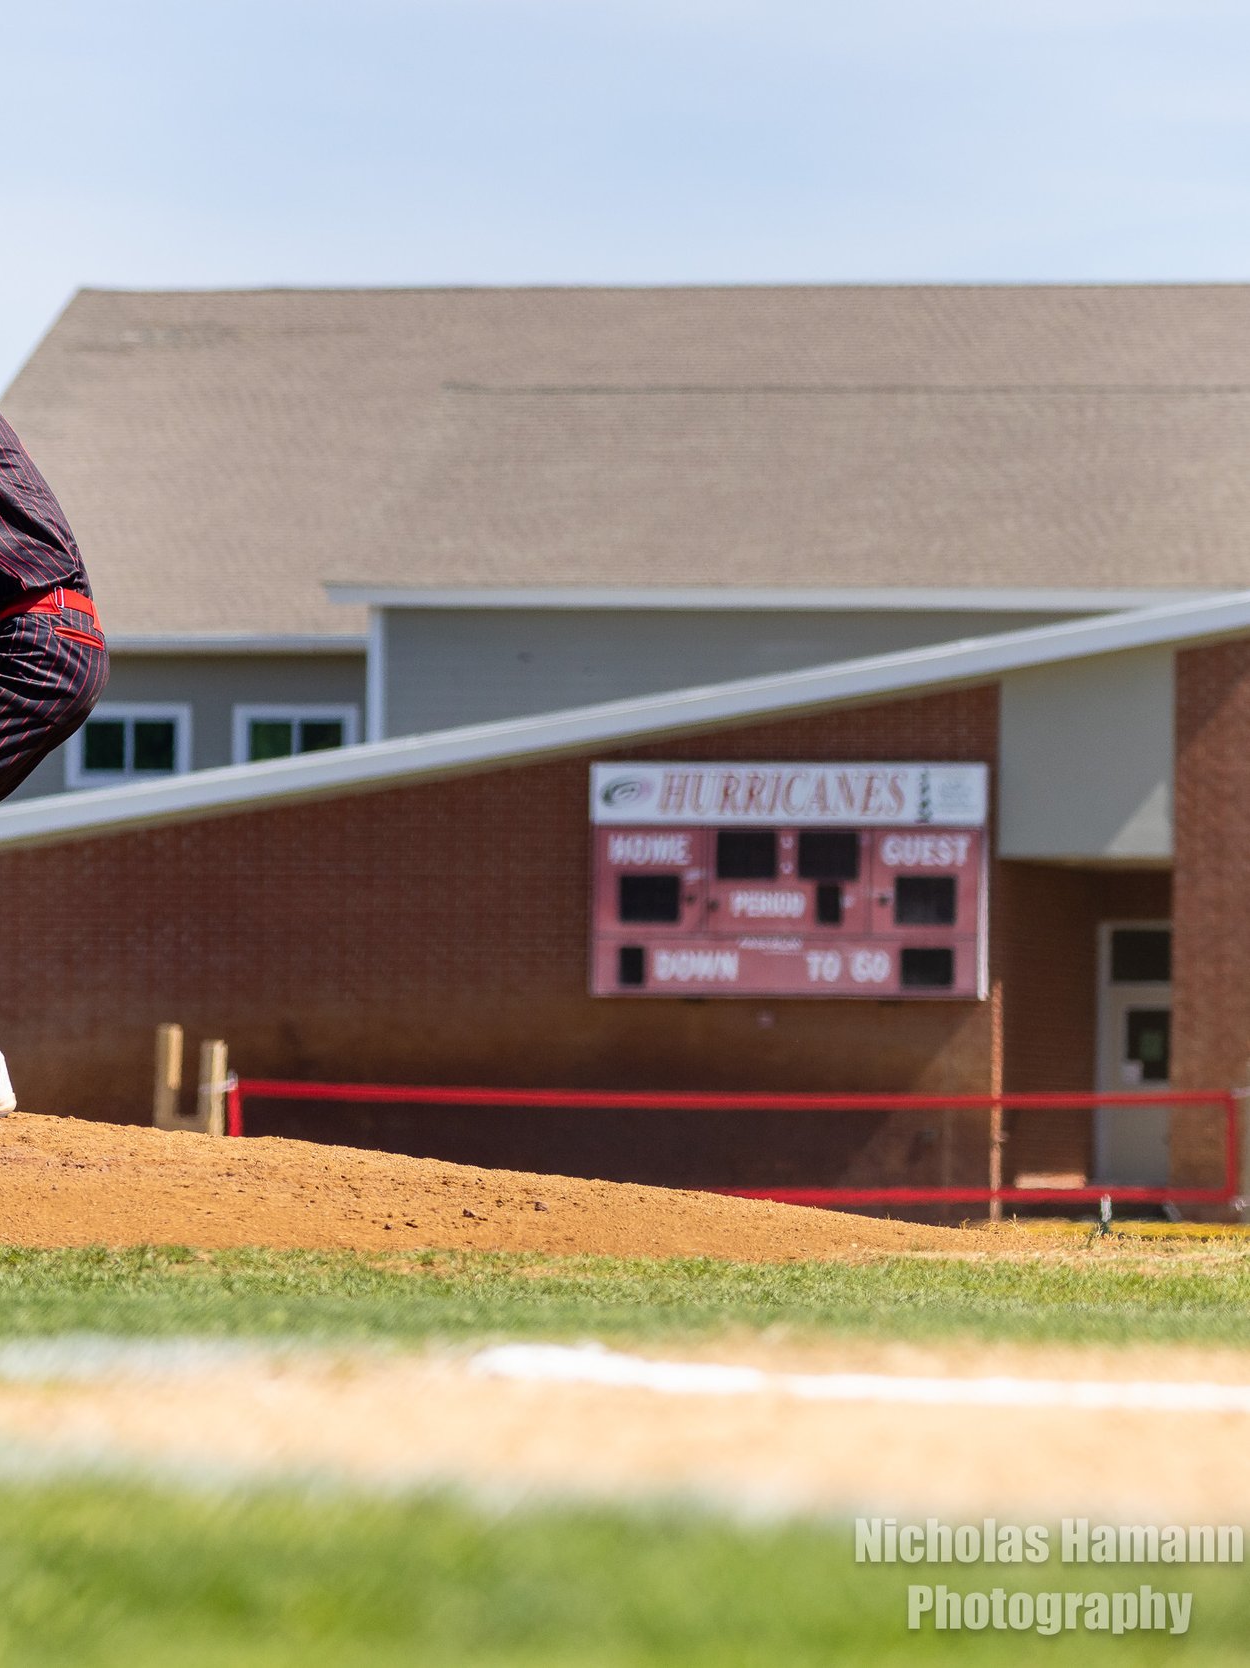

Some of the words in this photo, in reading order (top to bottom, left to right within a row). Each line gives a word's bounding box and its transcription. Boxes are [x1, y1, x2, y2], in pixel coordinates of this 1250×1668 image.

[657, 770, 907, 817] HURRICANES
[608, 833, 692, 866] HOME
[881, 834, 971, 867] GUEST
[730, 890, 806, 919] PERIOD
[653, 951, 739, 981] DOWN
[806, 951, 842, 982] TO
[851, 951, 891, 982] GO
